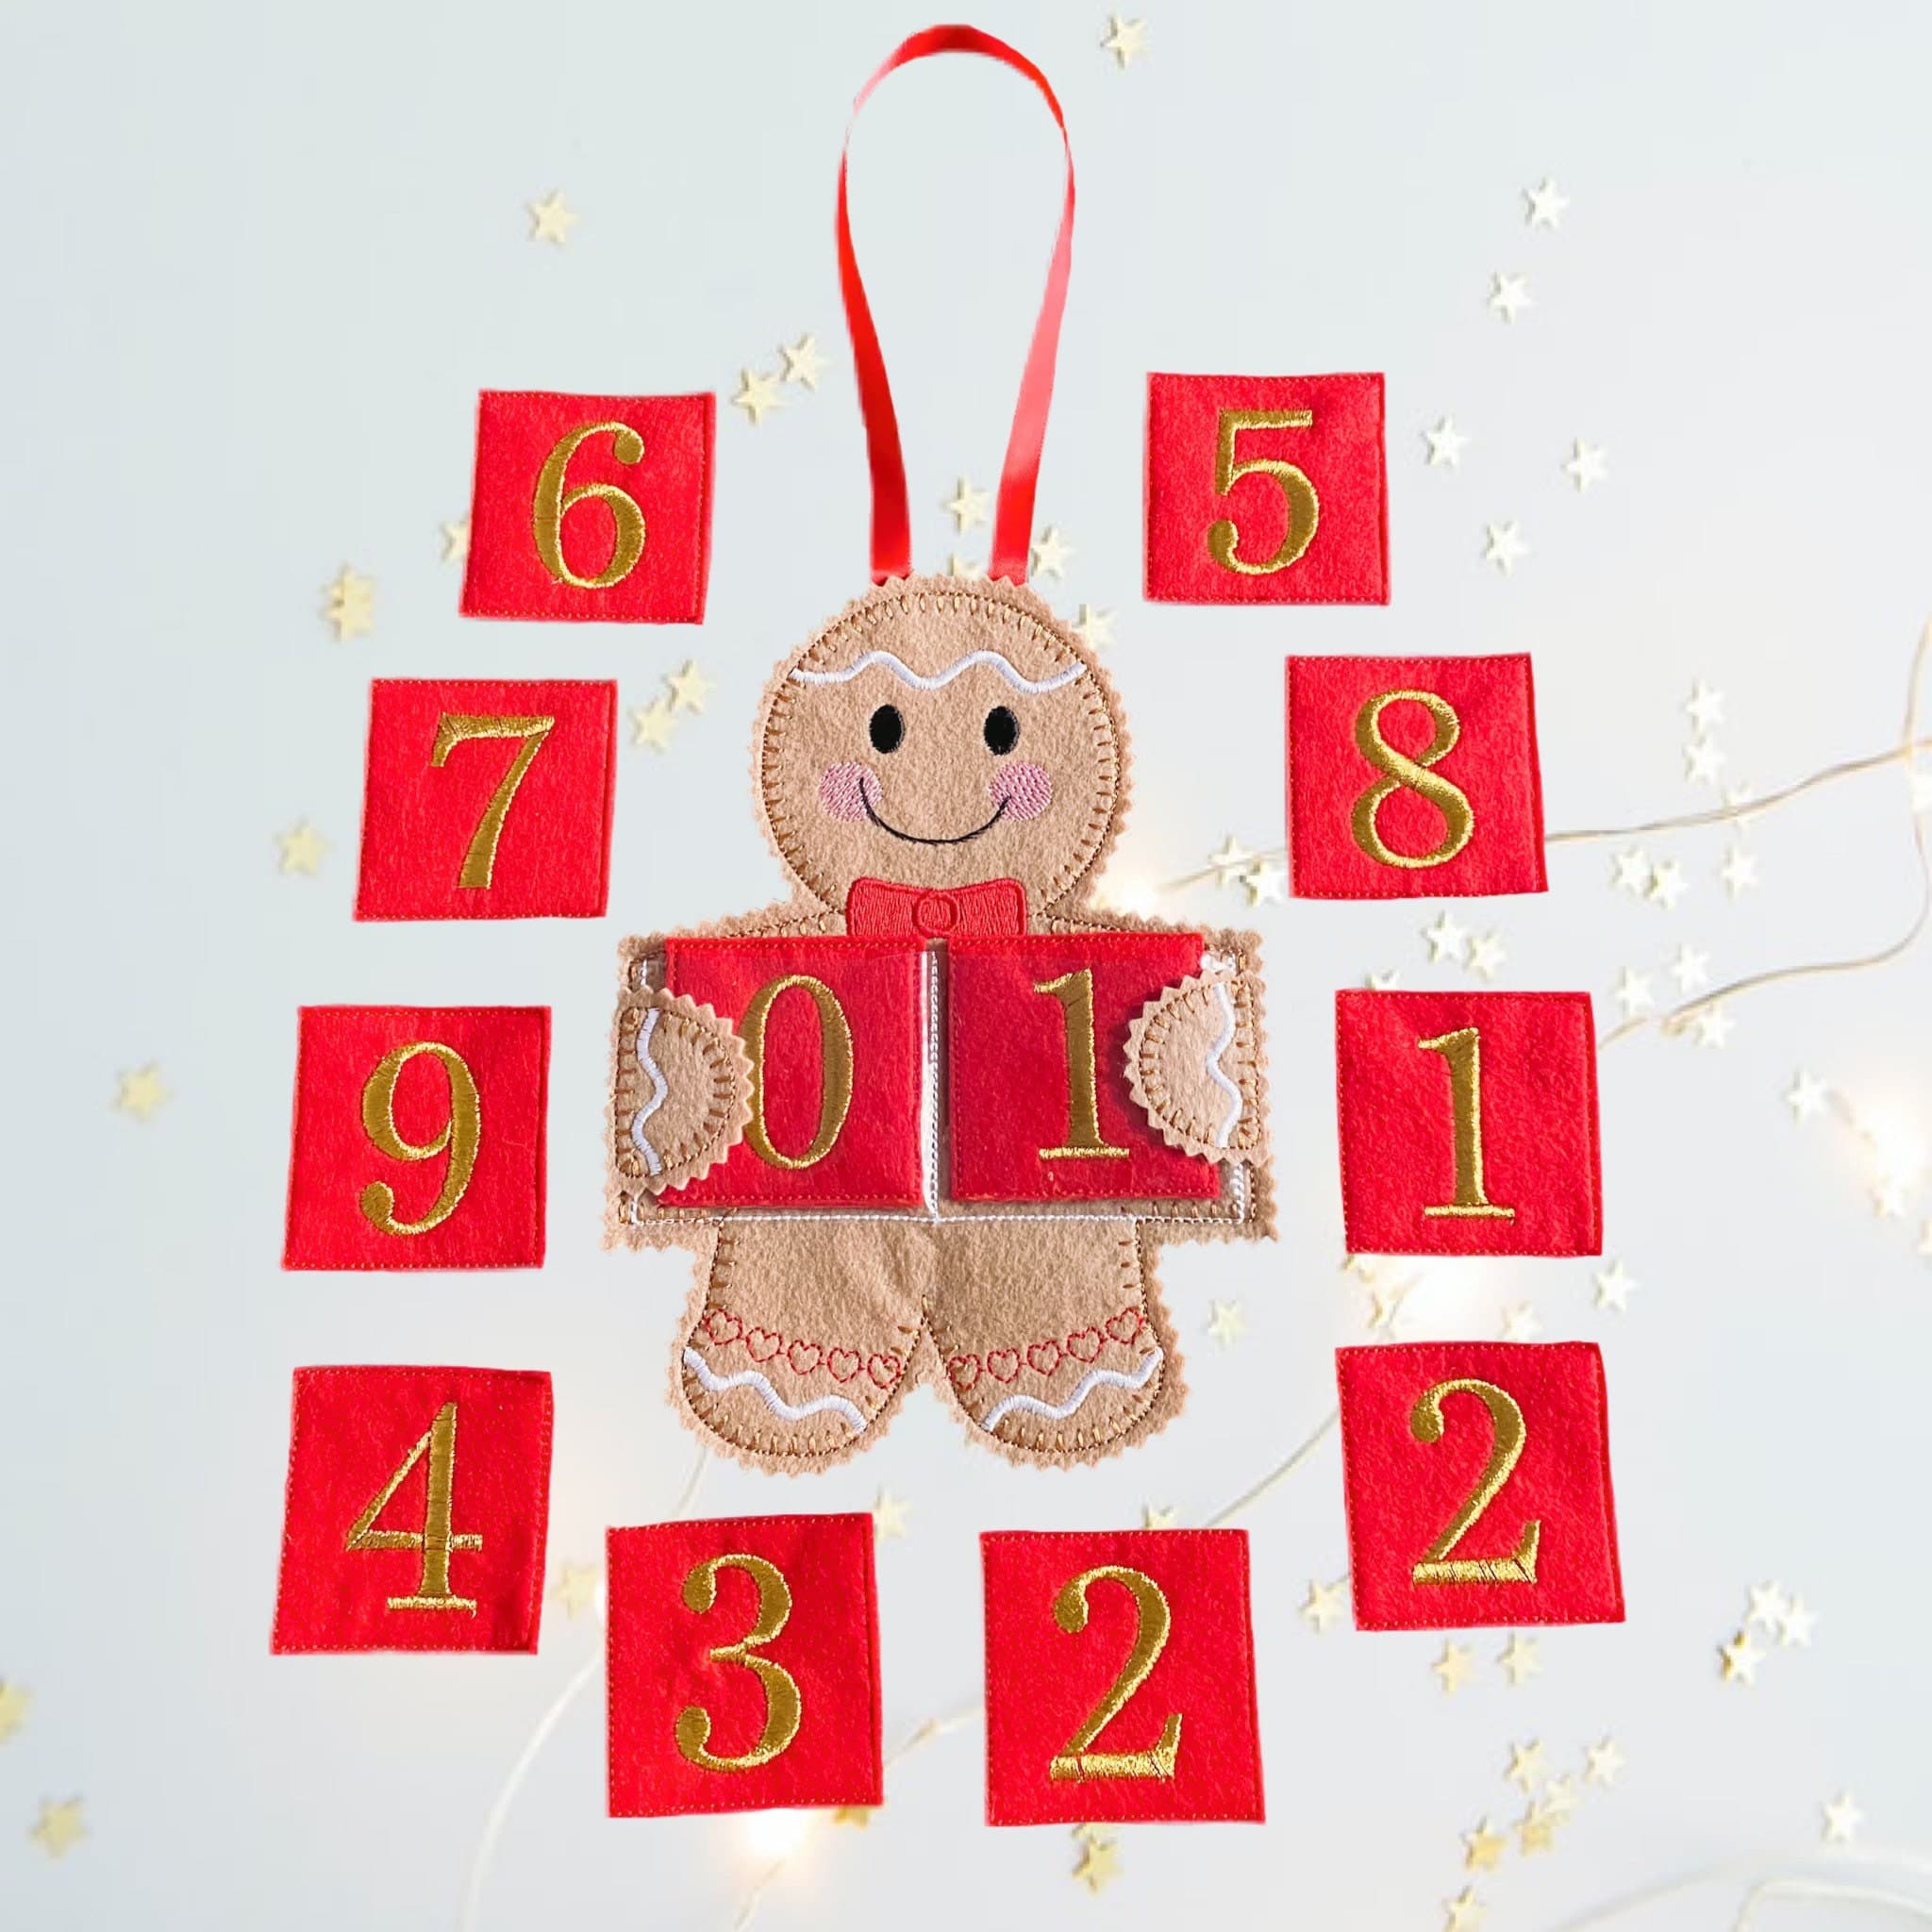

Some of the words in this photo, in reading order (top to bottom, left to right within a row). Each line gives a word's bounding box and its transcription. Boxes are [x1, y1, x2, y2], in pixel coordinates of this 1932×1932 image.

[534, 421, 645, 589] 6
[1209, 410, 1319, 575] 5
[432, 714, 554, 888] 7
[1353, 690, 1474, 868] 8
[362, 1041, 480, 1235] 9
[1034, 969, 1130, 1159] 1
[1418, 1027, 1514, 1218] 1
[347, 1403, 482, 1611] 4
[1411, 1378, 1541, 1584] 2
[675, 1554, 802, 1771] 3
[1050, 1566, 1182, 1780] 2
